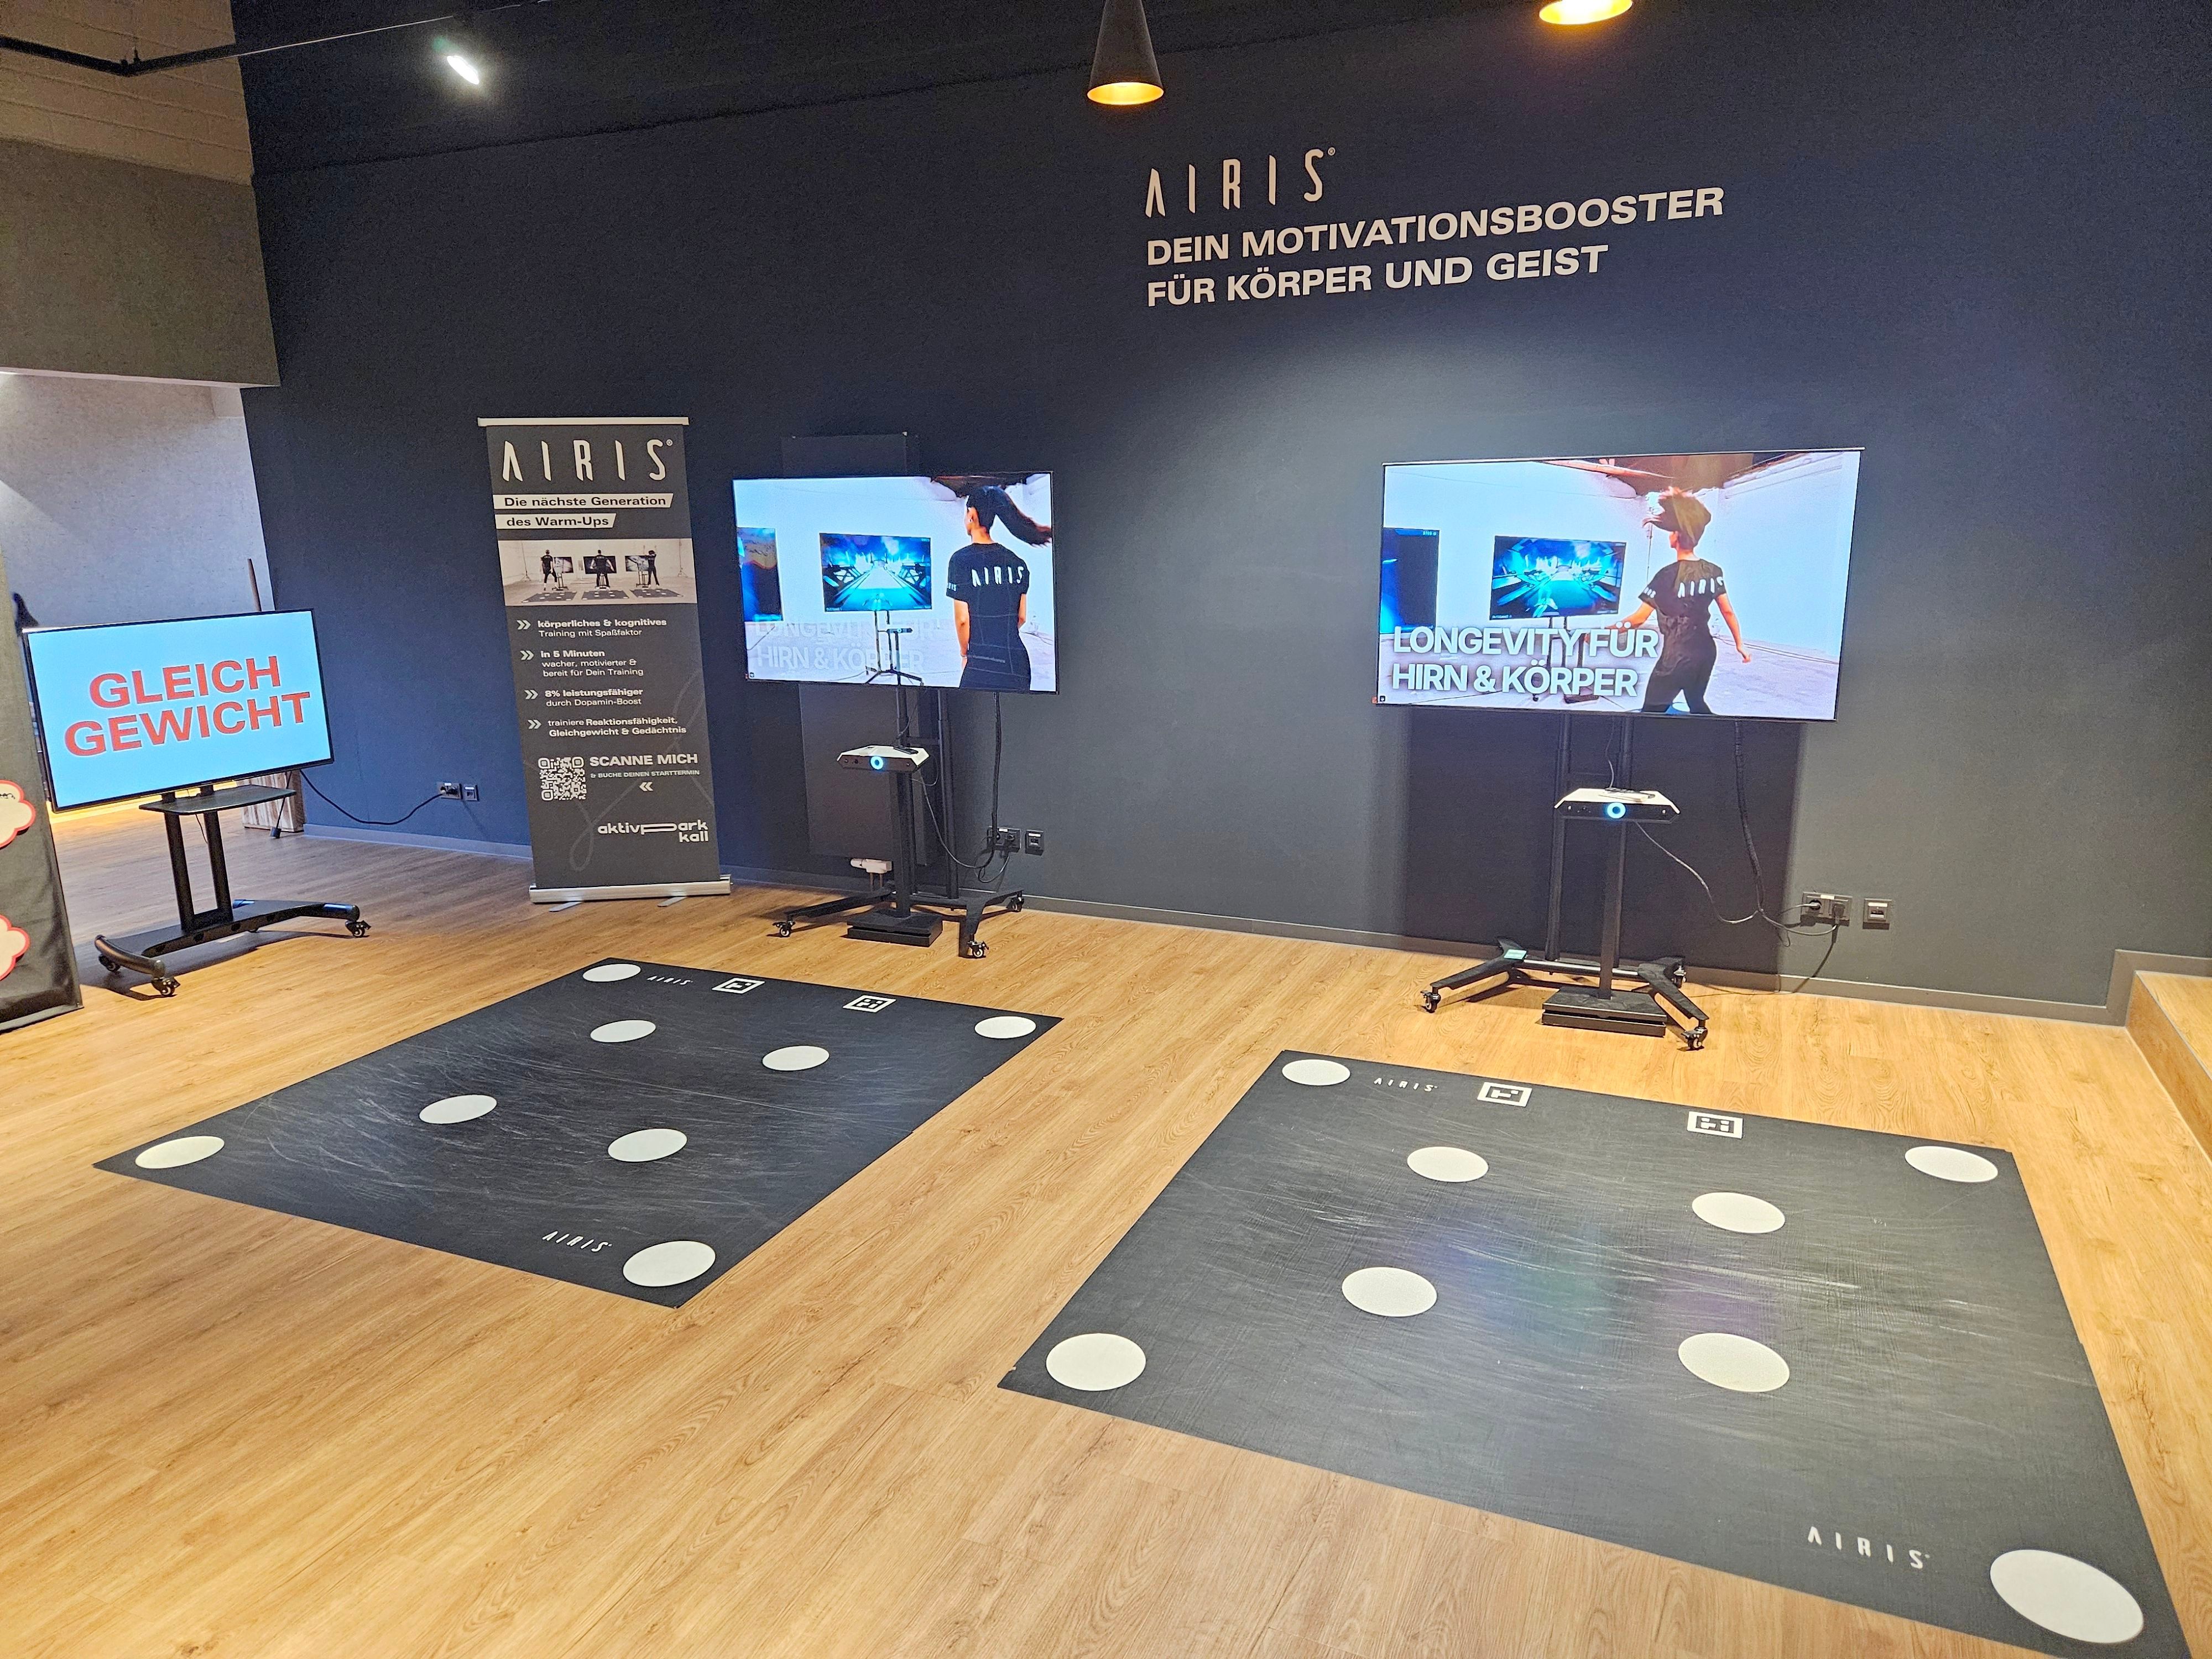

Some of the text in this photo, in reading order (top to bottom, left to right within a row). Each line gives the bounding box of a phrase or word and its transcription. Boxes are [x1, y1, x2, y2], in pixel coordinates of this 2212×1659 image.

[1147, 187, 1724, 265] DEIN MOTIVATIONSBOOSTER
[1148, 244, 1608, 307] FÜR KÖRPER UND GEIST
[504, 496, 666, 507] Die nächste Generation
[507, 516, 609, 527] des Warm-Ups
[972, 566, 1024, 587] AIRIS
[538, 619, 600, 629] körperliches
[615, 618, 667, 627] kognitives
[539, 629, 575, 638] Training
[595, 629, 642, 637] Spaßfaktor
[1394, 622, 1658, 658] LONGEVITY FÜR
[758, 646, 809, 669] HIRN
[814, 649, 829, 669] &
[90, 656, 281, 708] GLEICH
[1392, 659, 1639, 697] HIRN & KÖRPER
[563, 688, 643, 697] leistungsfähiger
[574, 698, 641, 706] Dopamin-Boost
[65, 692, 311, 757] GEWICHT
[586, 717, 678, 726] Reaktionsfähigkeit,
[549, 728, 619, 737] Gleichgewicht
[632, 726, 687, 734] Gedächtnis
[589, 754, 698, 766] SCANNE MICH
[679, 831, 708, 842] kall
